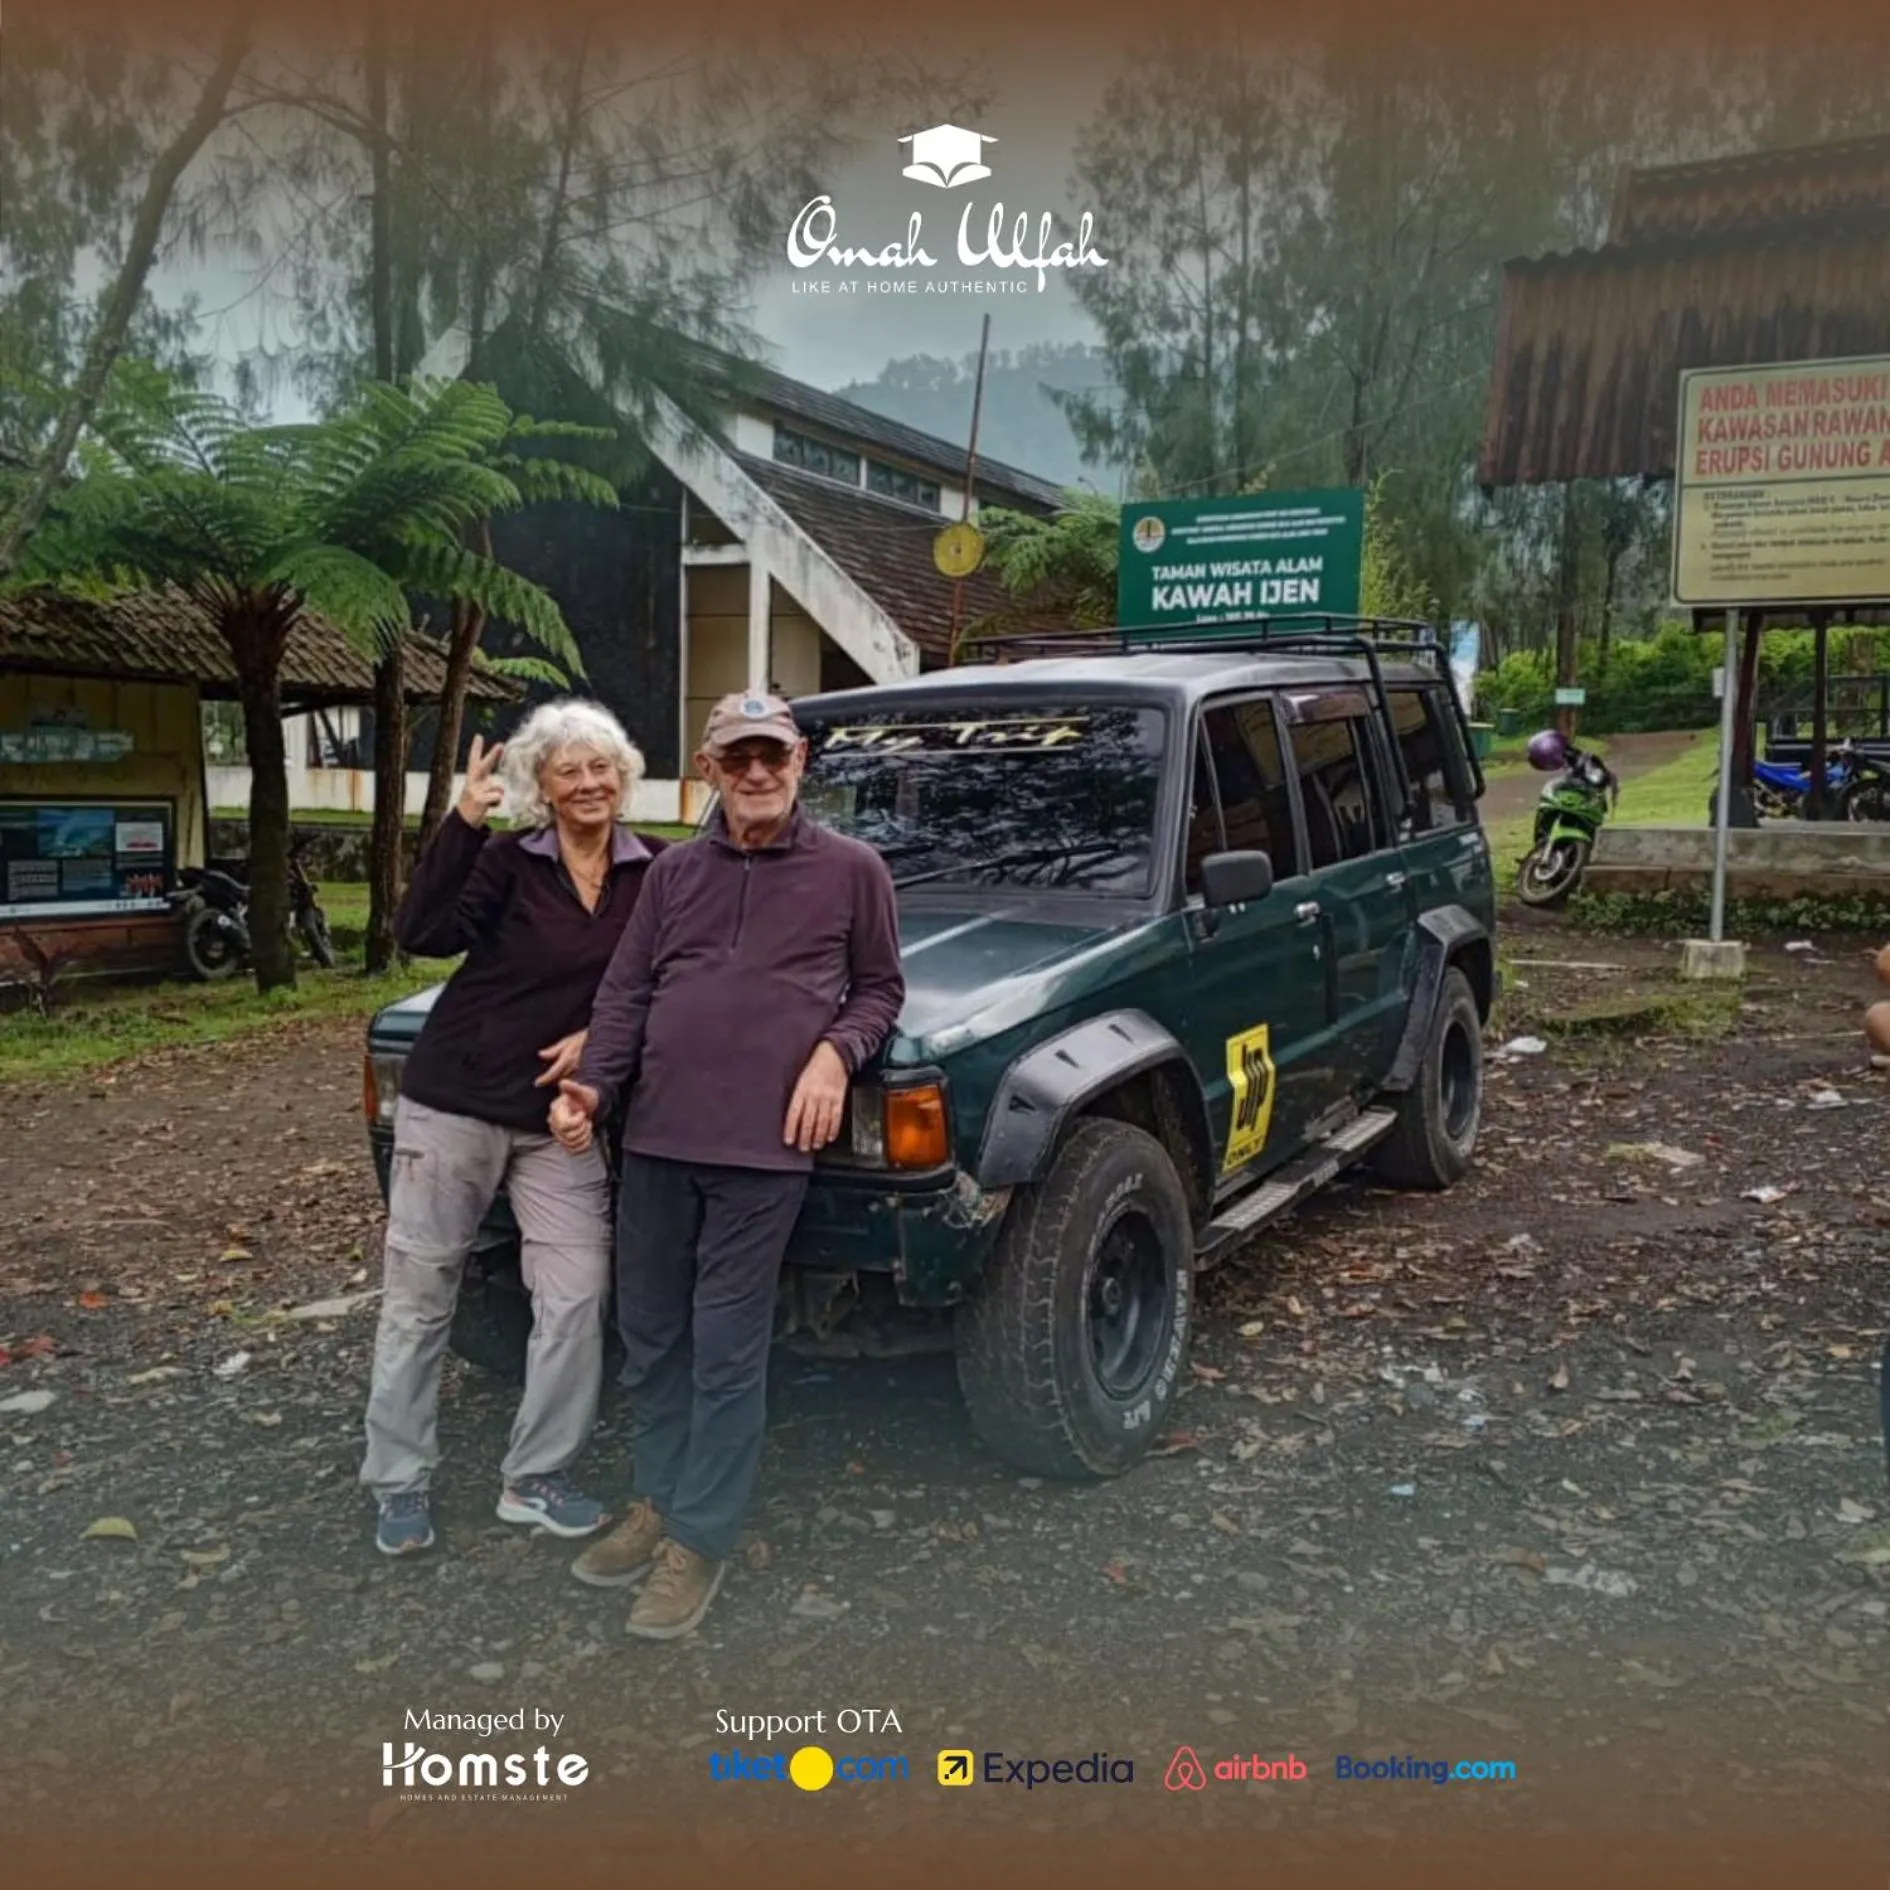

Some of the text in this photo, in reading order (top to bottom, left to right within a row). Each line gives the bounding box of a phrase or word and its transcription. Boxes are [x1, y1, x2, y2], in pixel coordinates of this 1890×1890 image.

[1700, 375, 1887, 412] ANDA MEMASUKI
[1698, 411, 1811, 443] KAWASAN
[1696, 446, 1770, 476] ERUPSI
[1778, 442, 1871, 471] GUNUNG
[1151, 556, 1324, 581] TAMAN WISATA ALAM
[1152, 578, 1320, 610] KAWAH IJEN
